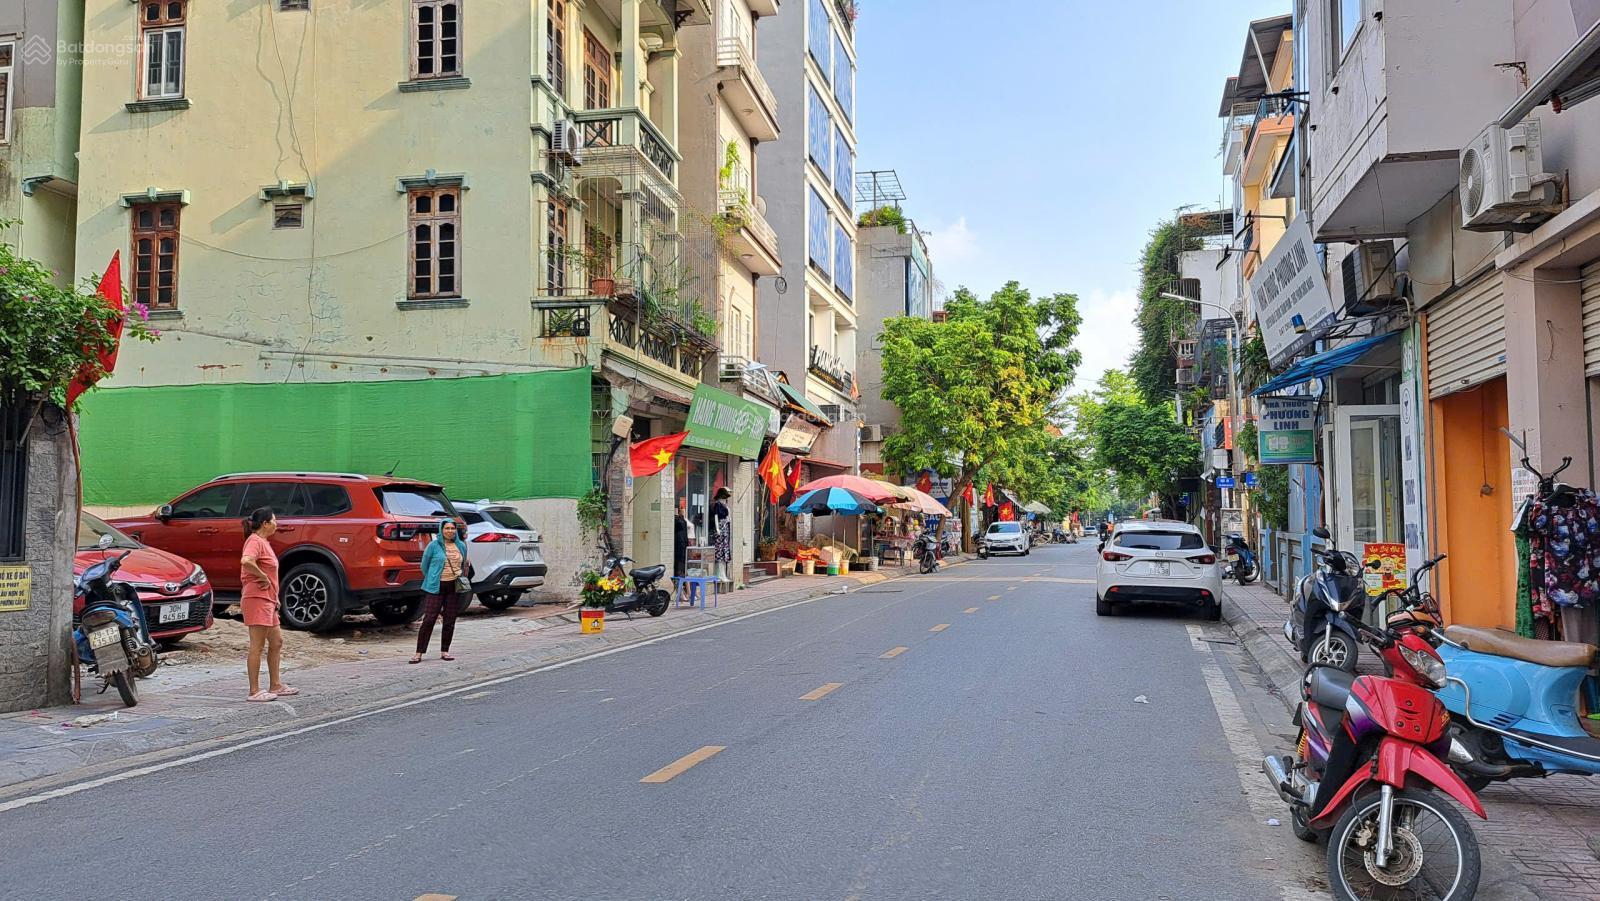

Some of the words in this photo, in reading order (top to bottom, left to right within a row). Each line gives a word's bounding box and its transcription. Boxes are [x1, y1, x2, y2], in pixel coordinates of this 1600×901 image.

[1292, 237, 1309, 273] LINH
[1402, 339, 1413, 372] 86
[1273, 421, 1299, 430] LINH
[7, 572, 13, 580] XE
